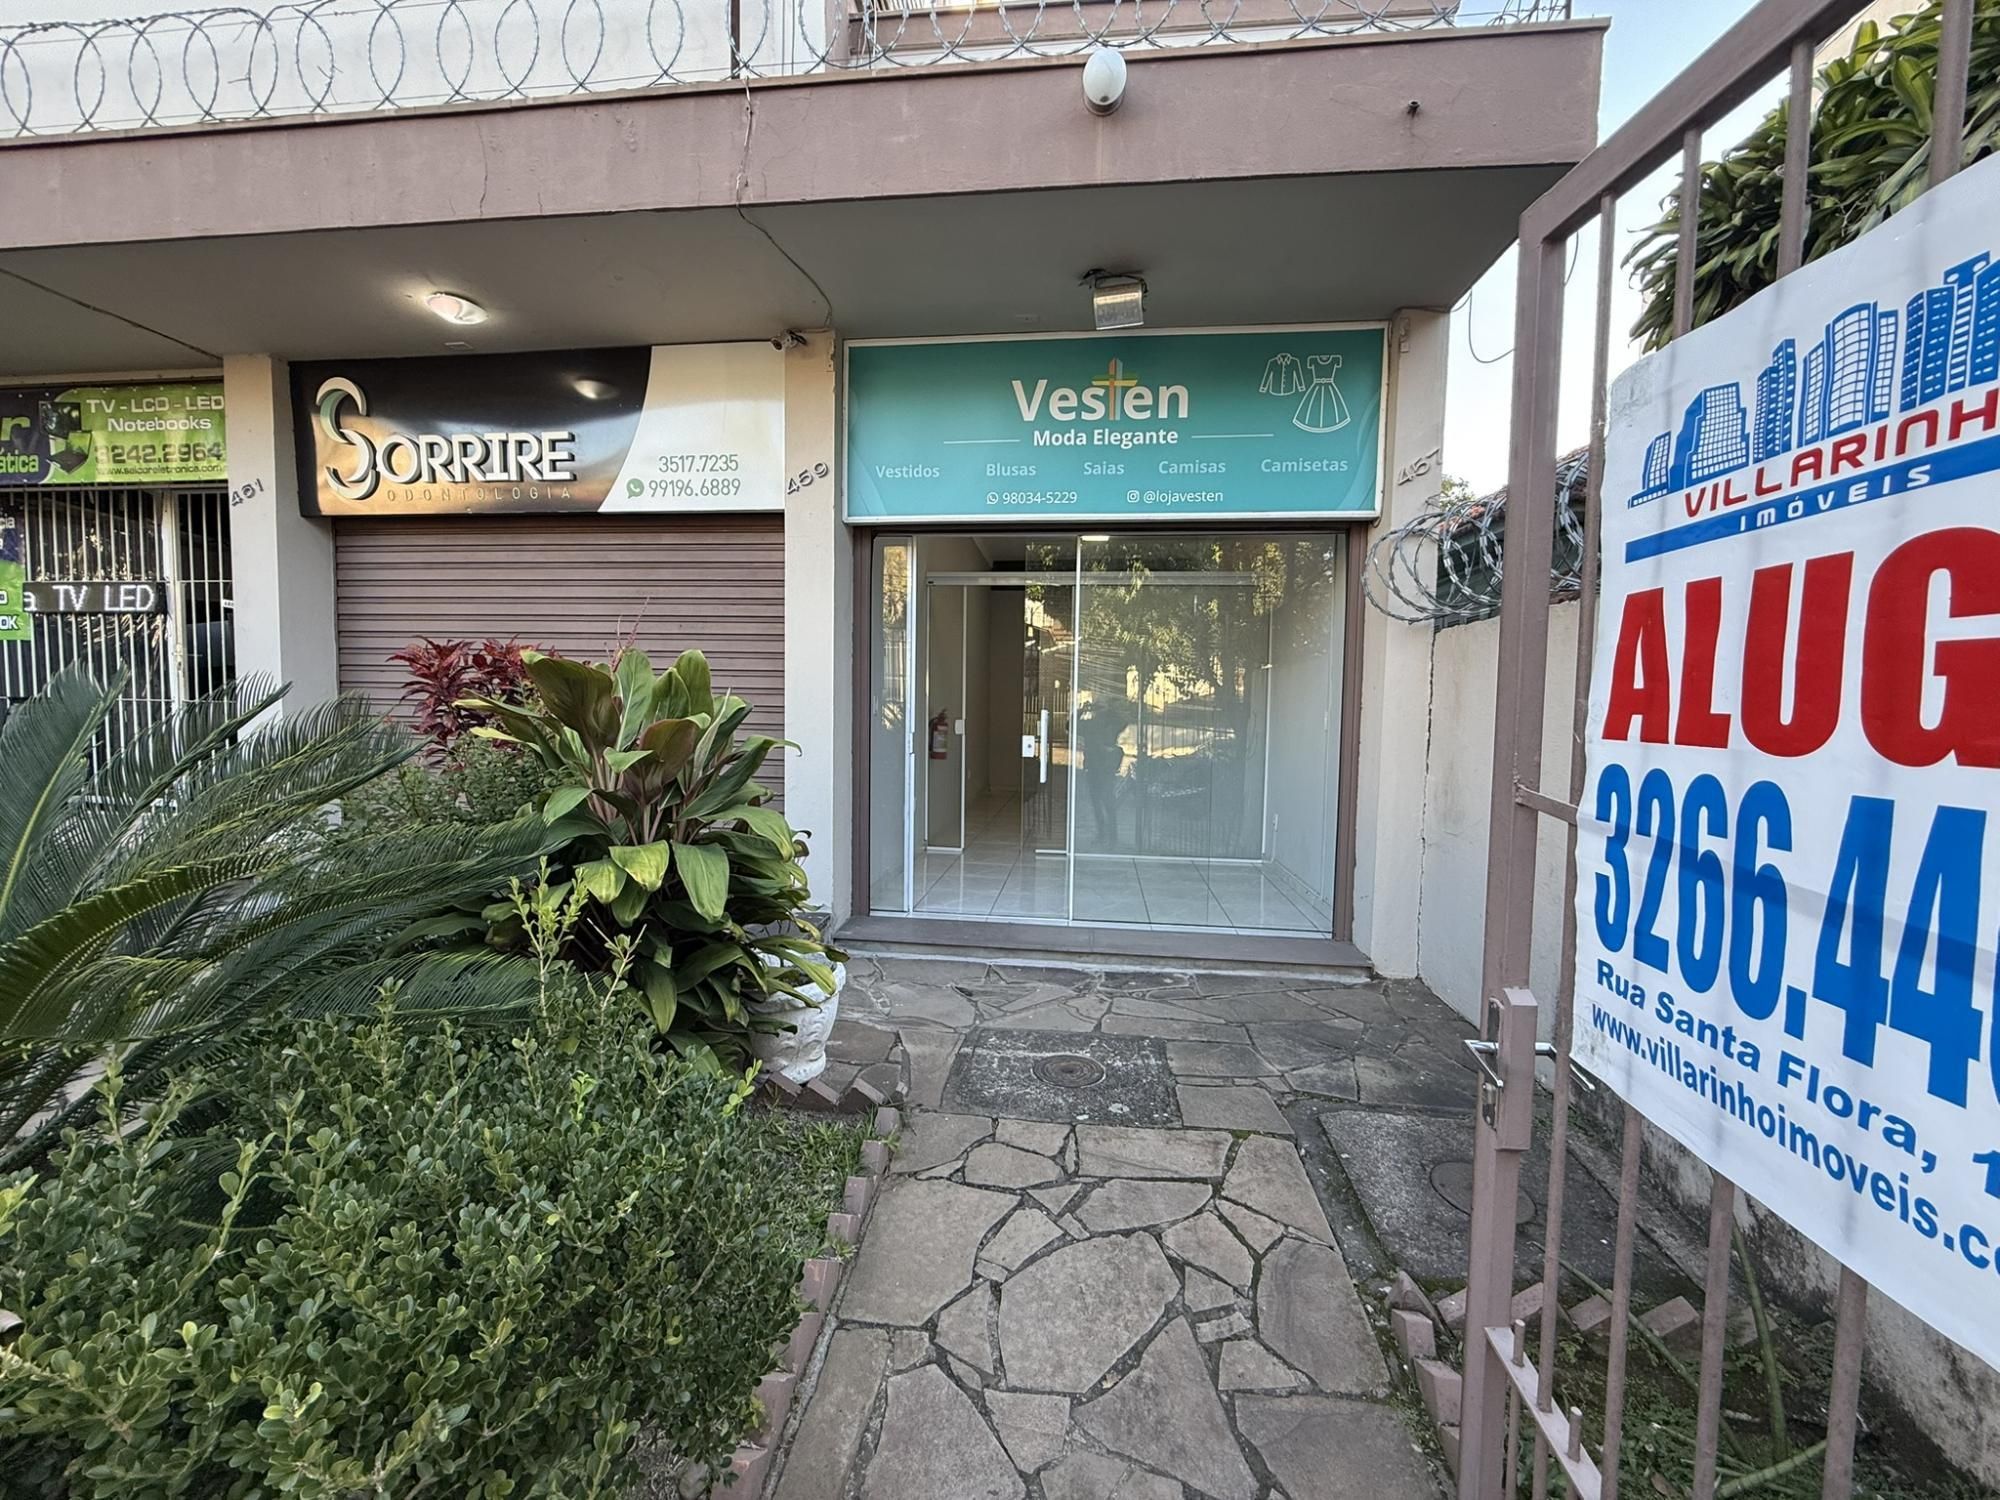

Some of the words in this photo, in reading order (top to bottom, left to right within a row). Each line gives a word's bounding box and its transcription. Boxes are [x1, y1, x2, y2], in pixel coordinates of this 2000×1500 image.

[1011, 357, 1189, 422] Vesten
[86, 399, 116, 414] TV
[131, 398, 170, 414] LCD
[185, 395, 224, 411] LED
[107, 416, 212, 433] Notebooks
[316, 376, 577, 500] SORRIRE
[1033, 429, 1087, 447] Moda
[1093, 428, 1179, 449] Elegante
[1685, 388, 2000, 518] VILLARINH
[658, 454, 739, 473] 3517.7235
[875, 464, 940, 479] Vestidos
[986, 462, 1037, 477] Blusas
[1083, 461, 1125, 476] Saias
[1158, 459, 1226, 475] Camisas
[1260, 457, 1348, 473] Camisetas
[648, 478, 741, 498] 99196.6889
[786, 461, 829, 495] 459
[386, 487, 572, 502] ODONTOLOGIA
[1002, 491, 1078, 504] 98034-5229
[1143, 489, 1224, 506] @lojavesten
[1740, 464, 1931, 532] IMÓVEIS
[52, 584, 88, 611] TV
[104, 584, 155, 611] LED
[1602, 526, 2000, 769] ALUG
[1594, 763, 2000, 1108] 3266.44
[1597, 958, 1646, 1010] Rua
[1655, 991, 1761, 1073] Santa
[1777, 1051, 1937, 1174] Flora,
[1592, 1003, 2000, 1276] www.villarinhoimoveis.c
